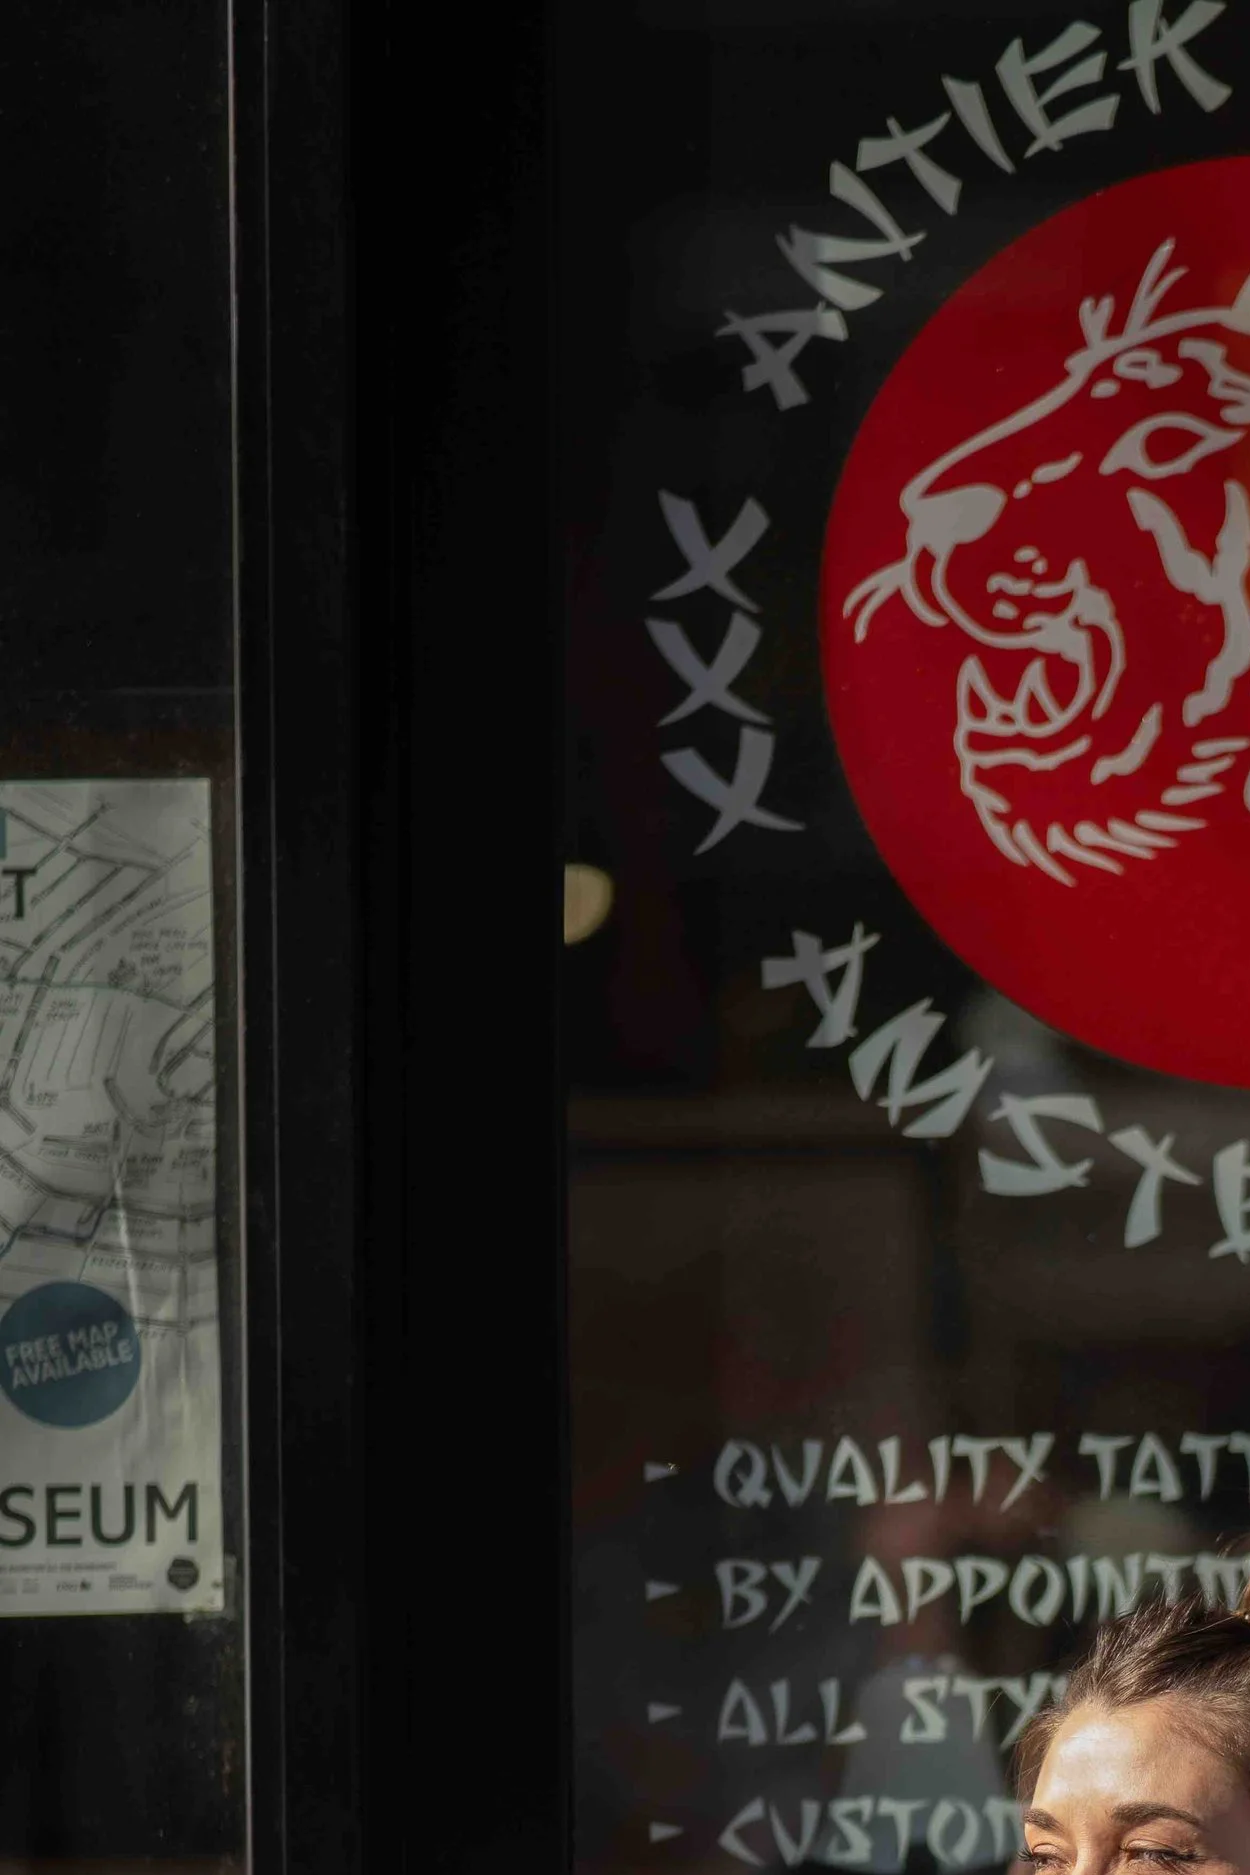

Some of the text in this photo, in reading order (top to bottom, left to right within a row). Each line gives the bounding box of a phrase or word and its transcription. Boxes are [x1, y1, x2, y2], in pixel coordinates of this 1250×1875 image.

[6, 1319, 119, 1367] FREE MAP
[13, 1339, 134, 1388] AVAILABLE
[713, 1433, 1054, 1512] QUALITY
[0, 1482, 199, 1547] SEUM
[714, 1556, 822, 1634] BY
[717, 1672, 1068, 1752] ALL STY
